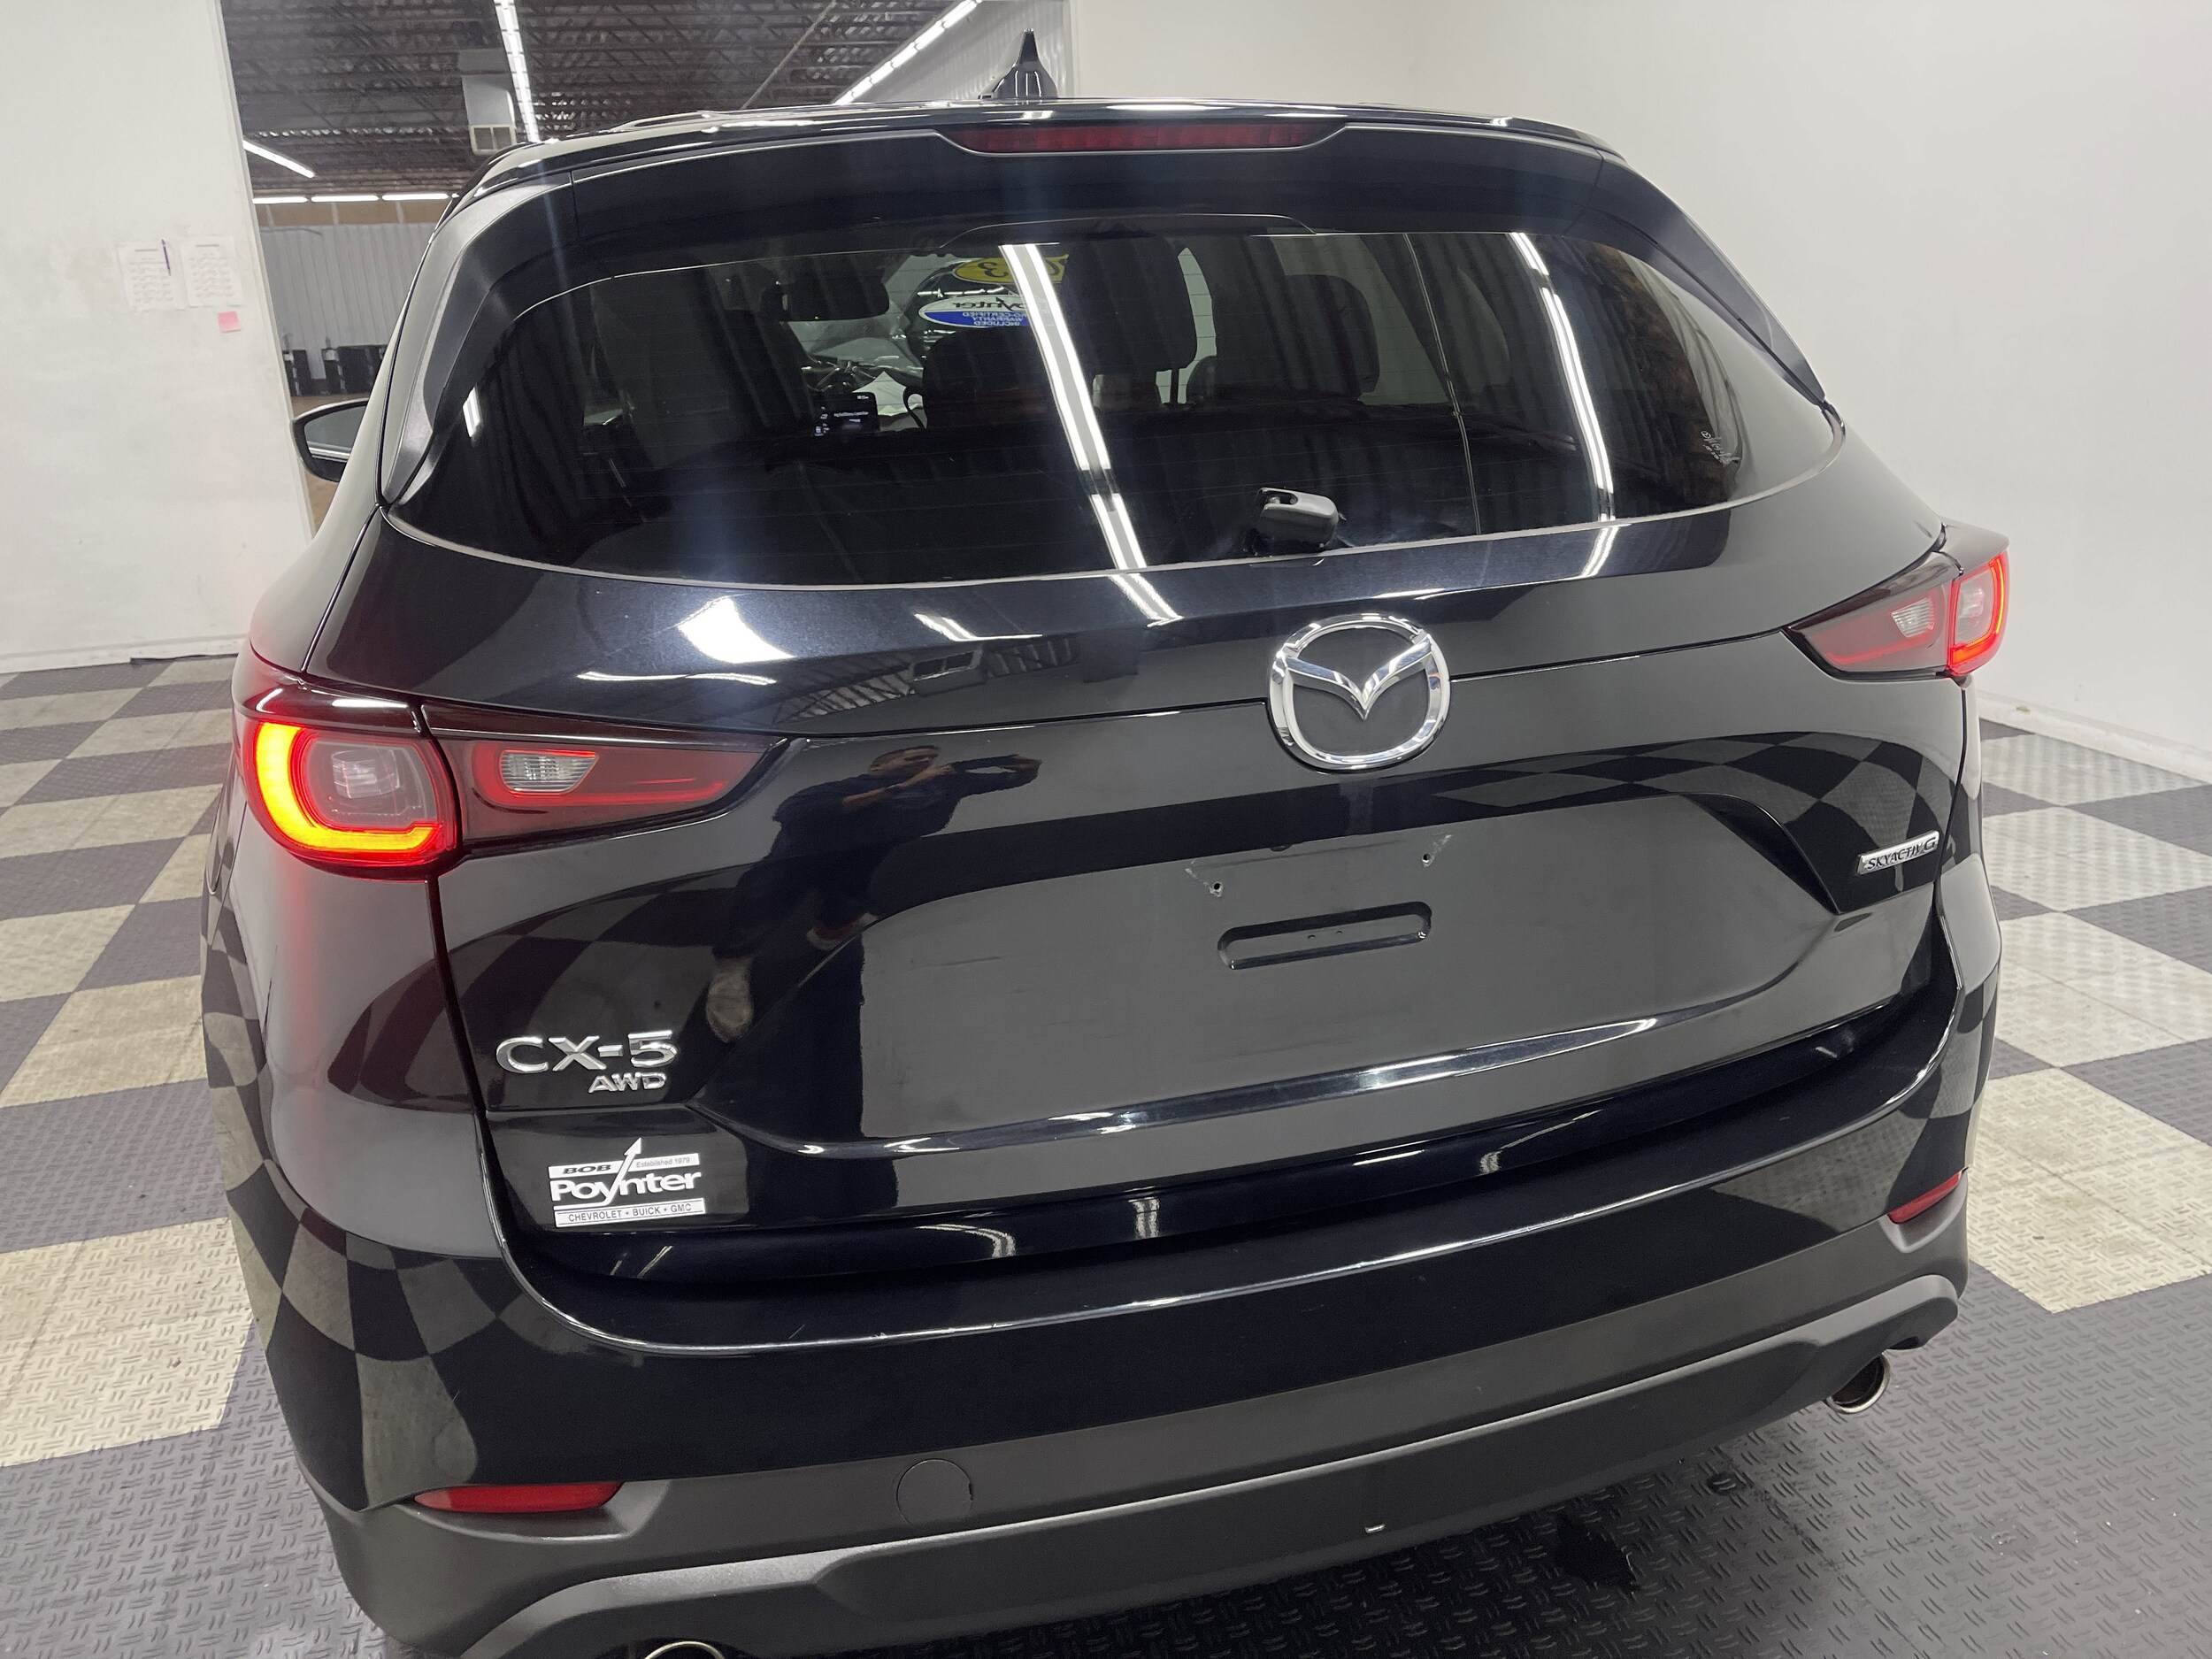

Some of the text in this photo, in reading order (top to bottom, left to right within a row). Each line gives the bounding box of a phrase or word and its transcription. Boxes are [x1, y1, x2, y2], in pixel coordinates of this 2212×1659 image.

[1866, 842, 1924, 870] SKYACTIV
[495, 1029, 678, 1074] CX-5
[588, 1071, 667, 1094] AWD
[562, 1164, 611, 1175] BOB
[635, 1156, 691, 1169] Established 1979
[549, 1168, 702, 1207] Poynter
[568, 1203, 692, 1222] CHEVROLET BUICK GMC
